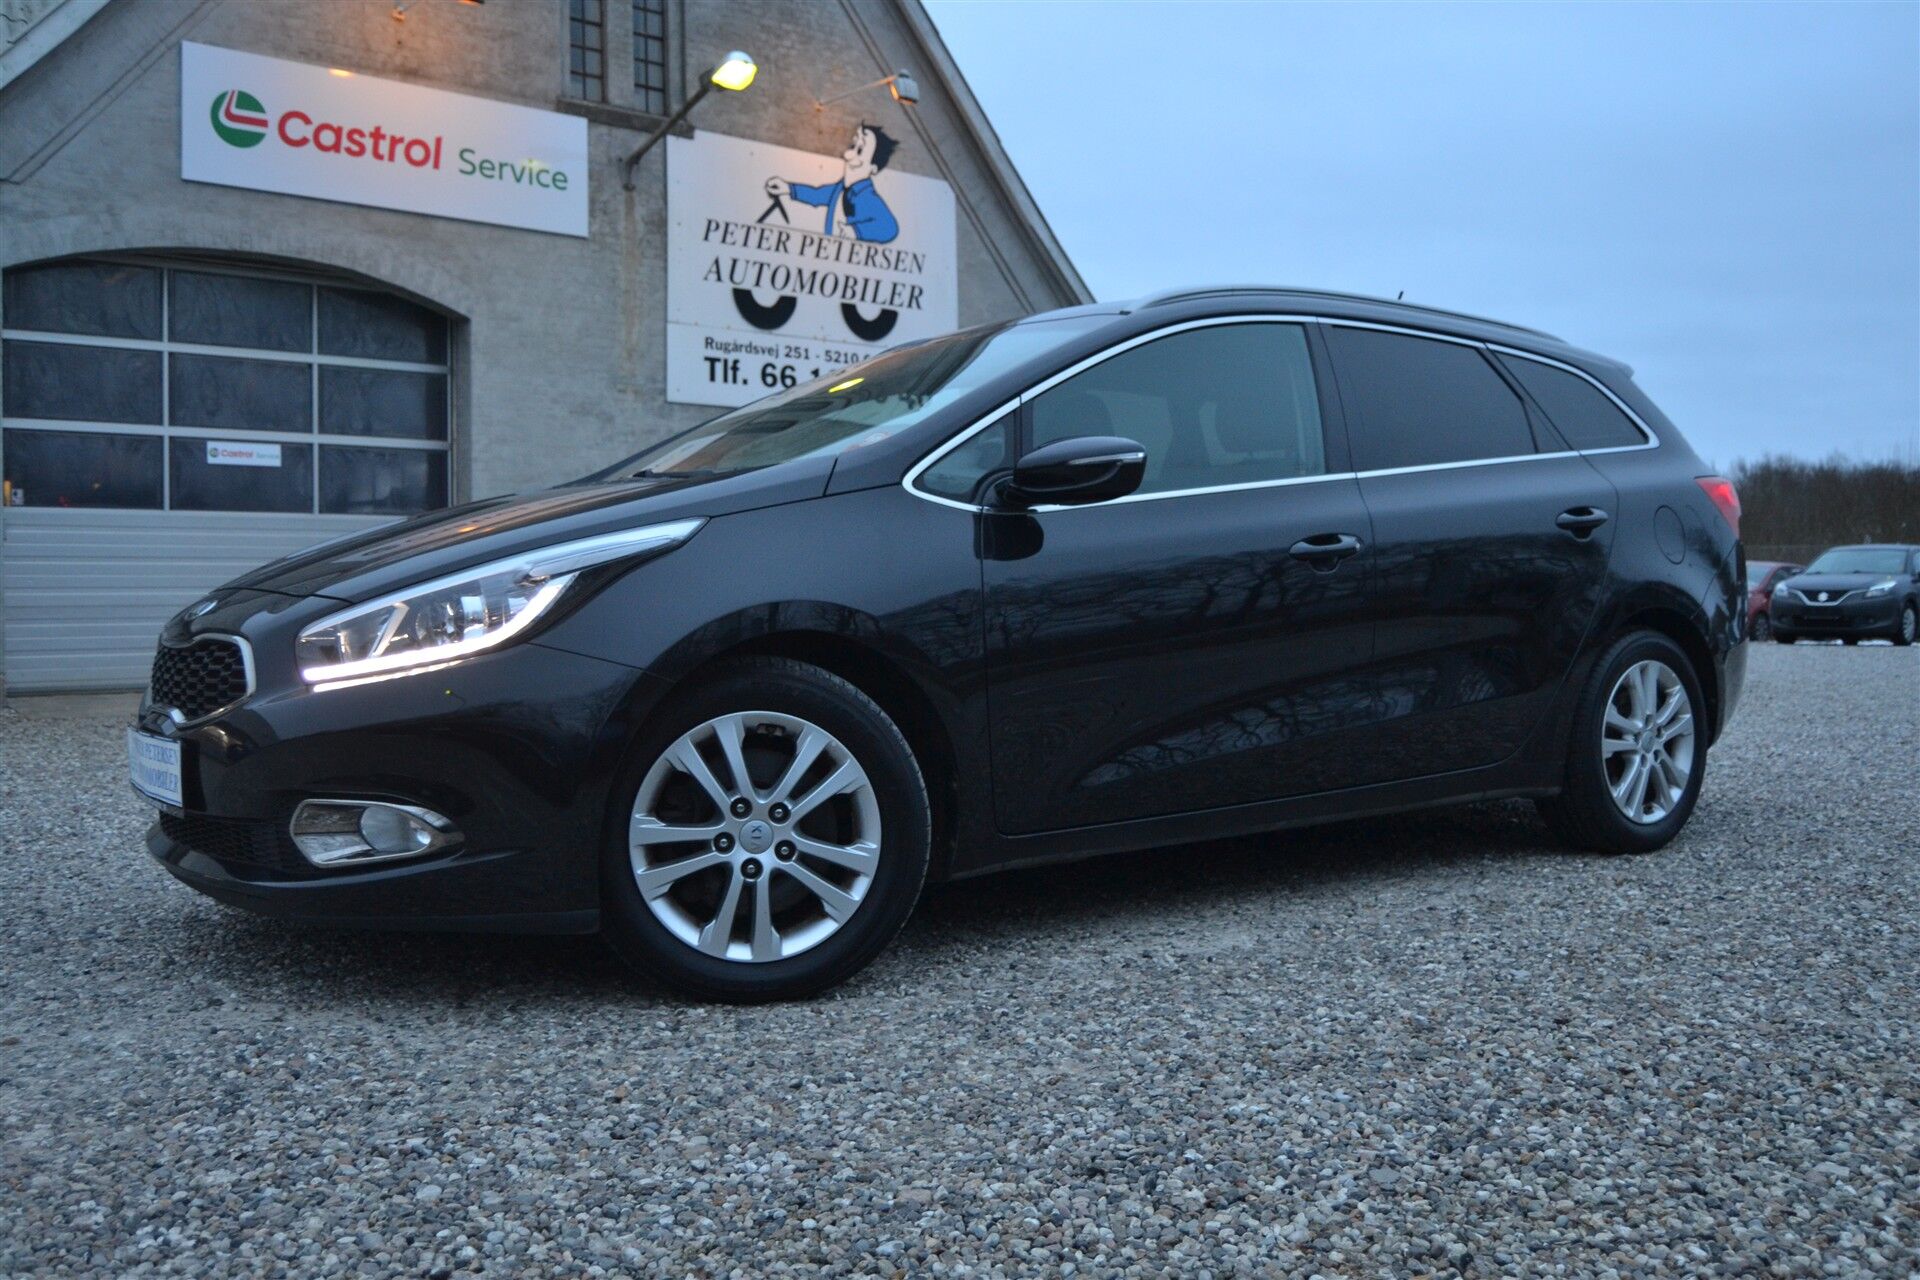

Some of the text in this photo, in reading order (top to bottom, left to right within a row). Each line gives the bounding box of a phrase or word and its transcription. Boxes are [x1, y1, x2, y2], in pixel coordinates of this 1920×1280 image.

[277, 110, 569, 191] Castrol Service
[702, 218, 926, 275] PETER PETERSEN
[703, 256, 924, 310] AUTOMOBILER
[704, 336, 780, 359] Rugårdsvej
[784, 345, 810, 360] 251
[825, 349, 859, 363] 5210
[704, 356, 748, 385] Tlf.
[761, 362, 797, 389] 66
